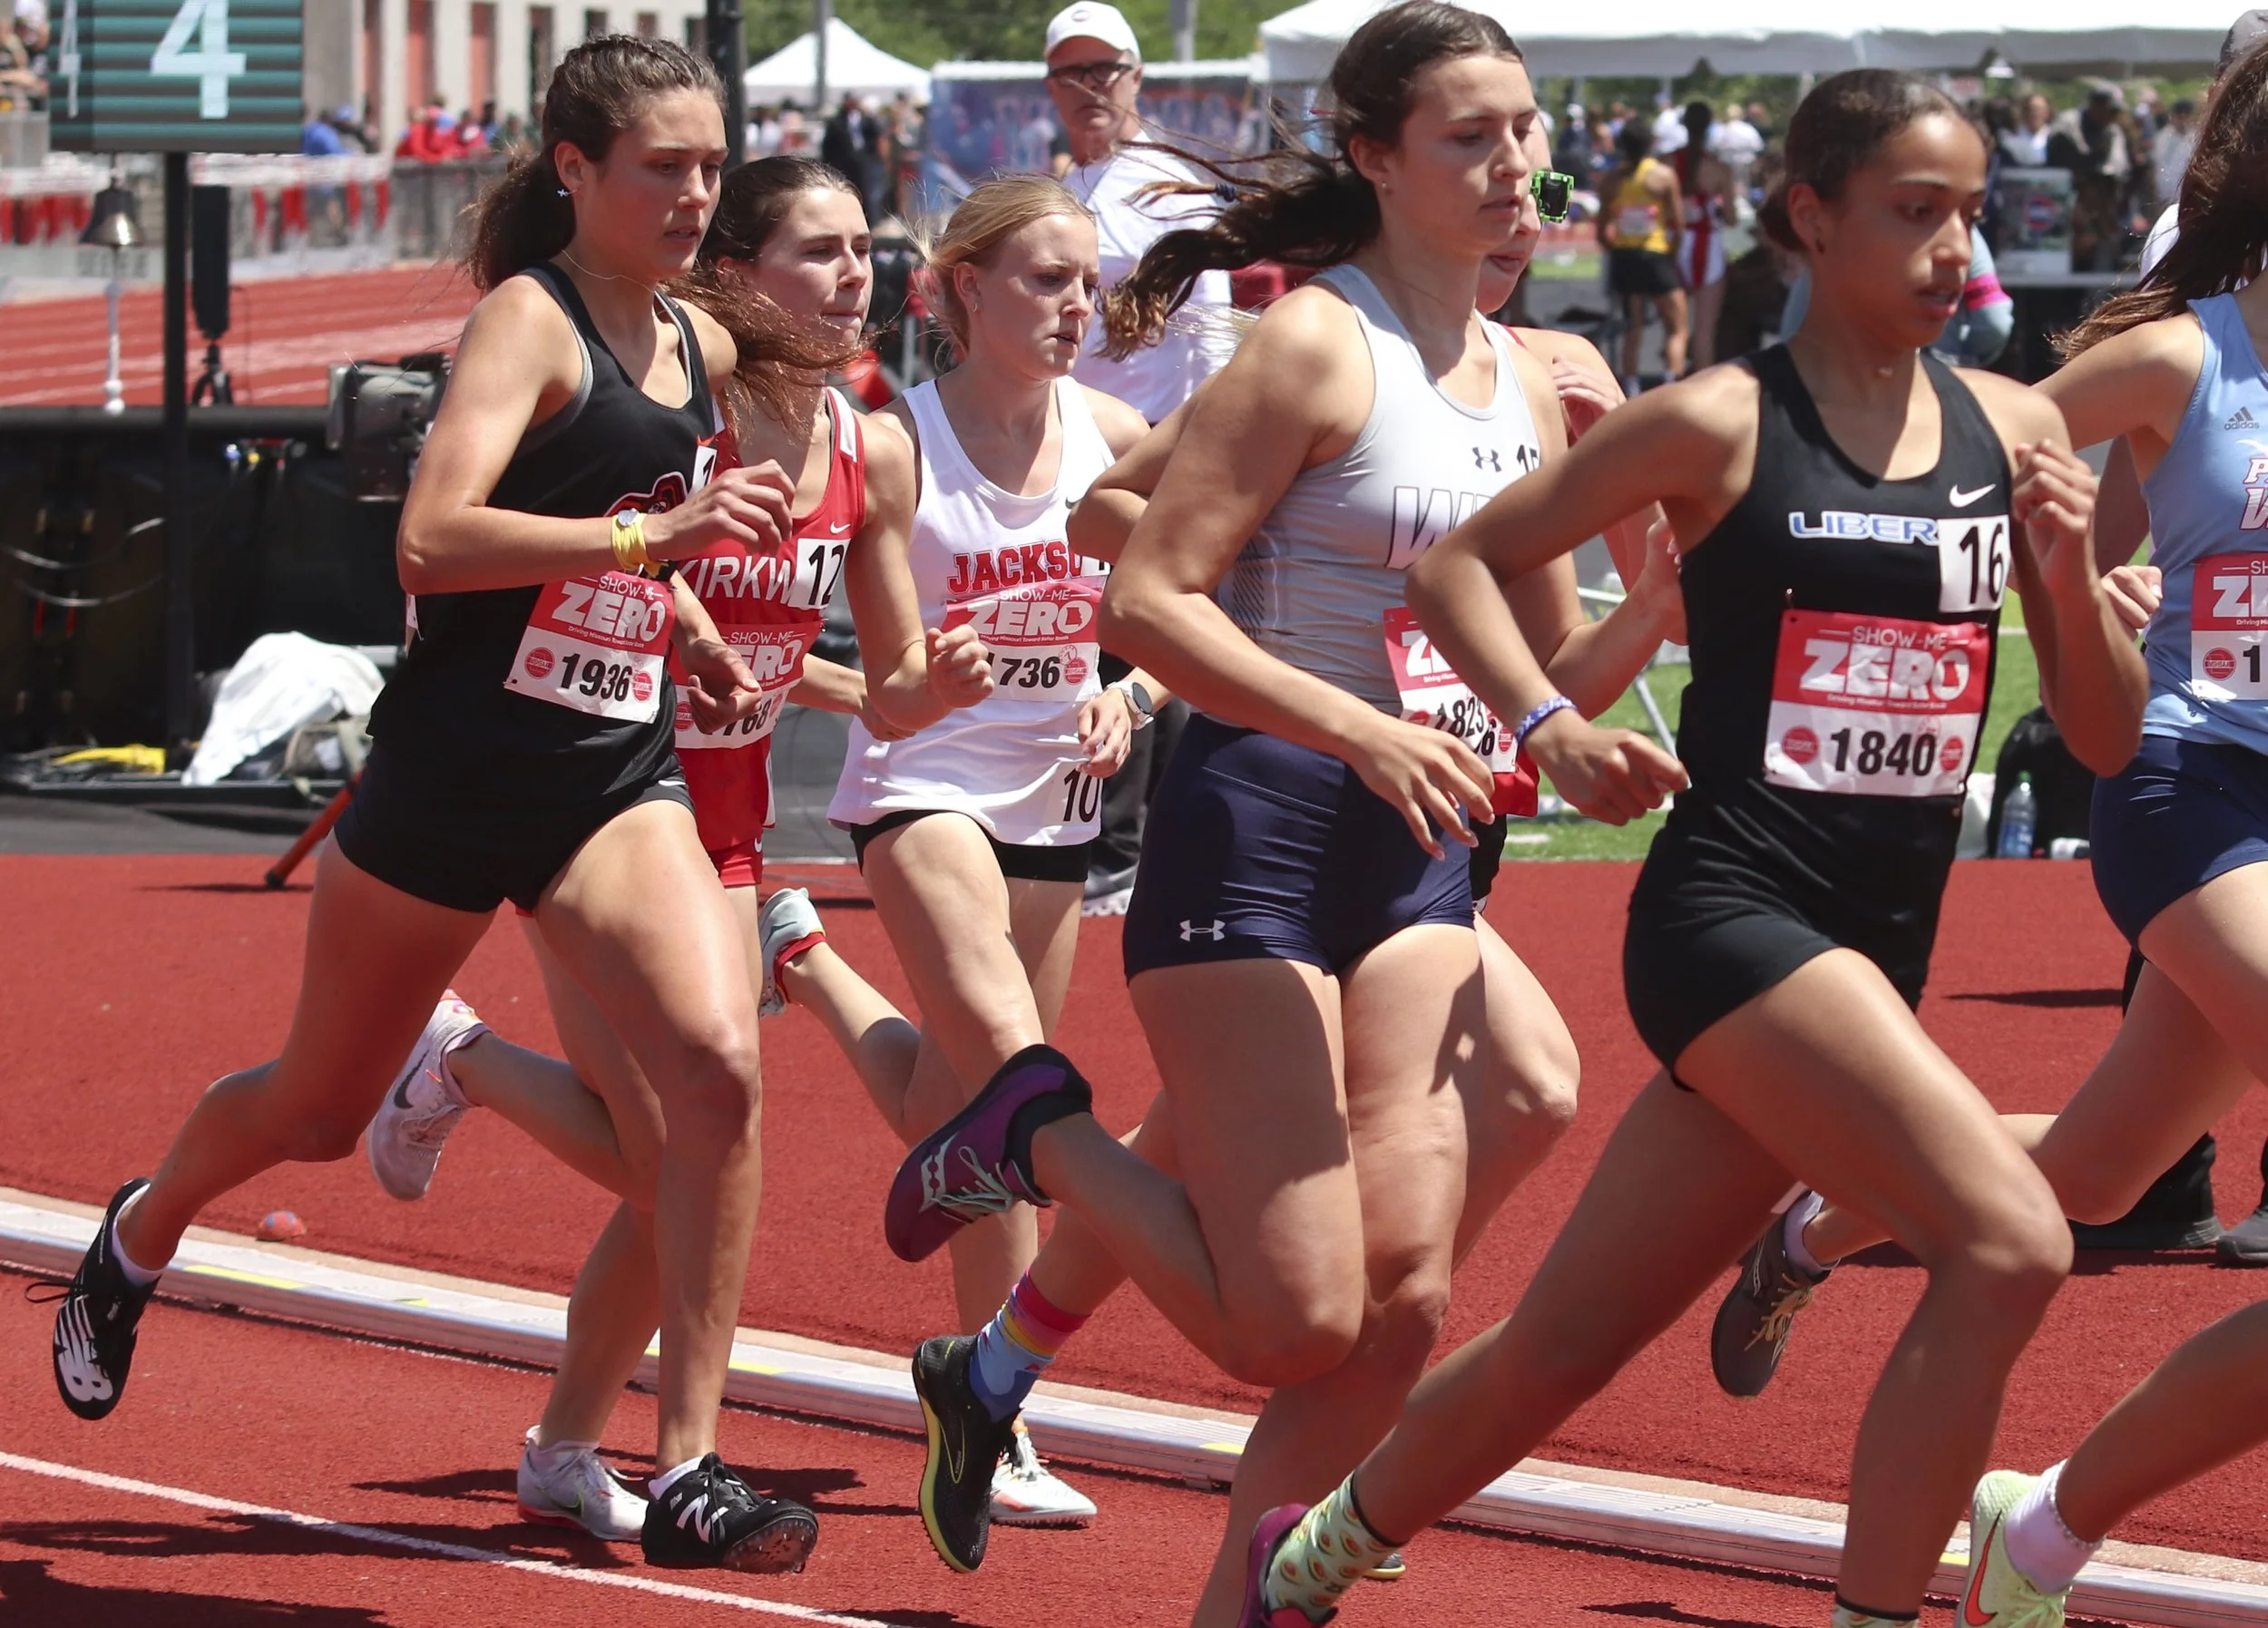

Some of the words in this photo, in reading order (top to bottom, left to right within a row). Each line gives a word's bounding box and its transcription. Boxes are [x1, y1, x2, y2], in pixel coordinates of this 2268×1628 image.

[149, 0, 247, 120] 4
[2224, 421, 2260, 431] adidas
[599, 574, 655, 601] SHOW-ME
[808, 543, 846, 606] 12
[1960, 524, 2003, 606] 16
[552, 580, 667, 642] ZERO
[965, 600, 1093, 635] ZERO
[999, 588, 1070, 601] SHOW-ME
[730, 630, 794, 645] SHOW-ME
[1853, 625, 1948, 652] SHOW-ME
[554, 652, 633, 702] 1936
[1799, 638, 1970, 701] ZERO
[1831, 727, 1938, 776] 1840
[1062, 767, 1100, 823] 10
